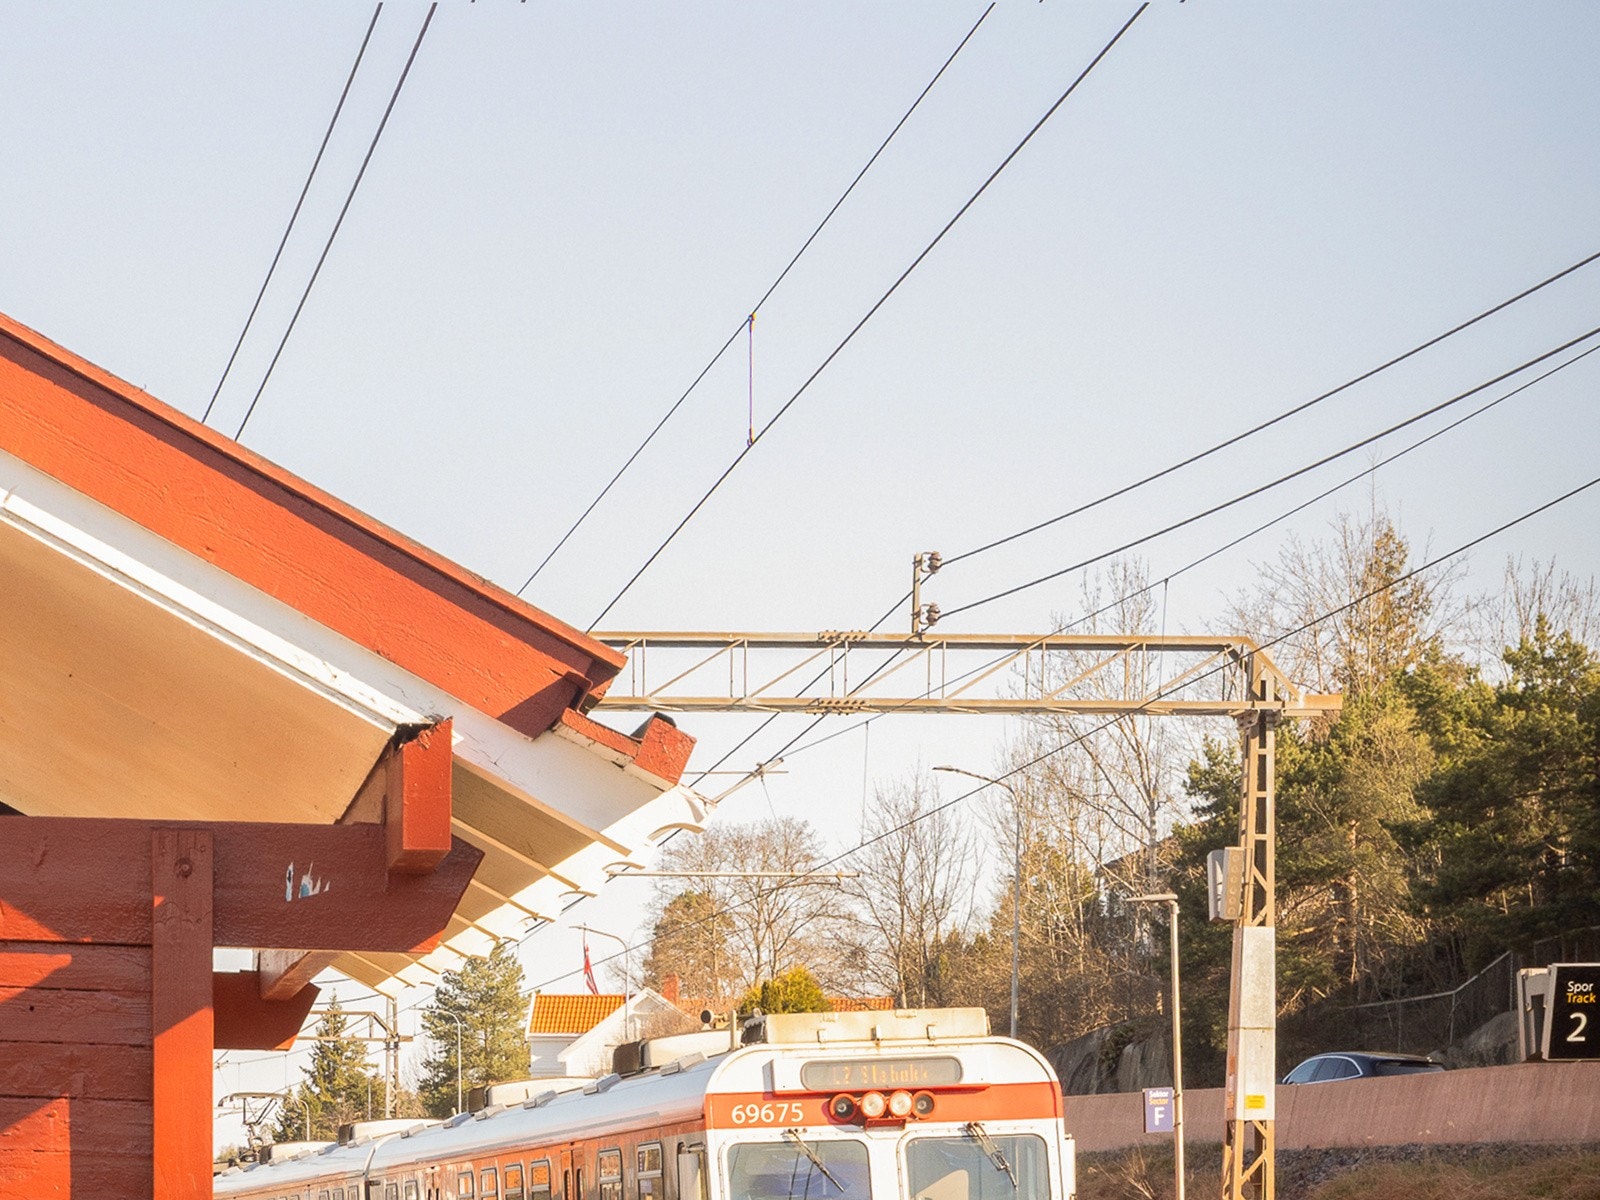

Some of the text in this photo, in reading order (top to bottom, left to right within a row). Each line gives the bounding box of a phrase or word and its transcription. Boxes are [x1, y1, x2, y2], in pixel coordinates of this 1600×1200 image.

[1567, 981, 1594, 993] Spor
[1566, 993, 1596, 1003] Track
[1566, 1012, 1587, 1042] 2
[731, 1103, 804, 1125] 69675
[1154, 1106, 1165, 1126] F
